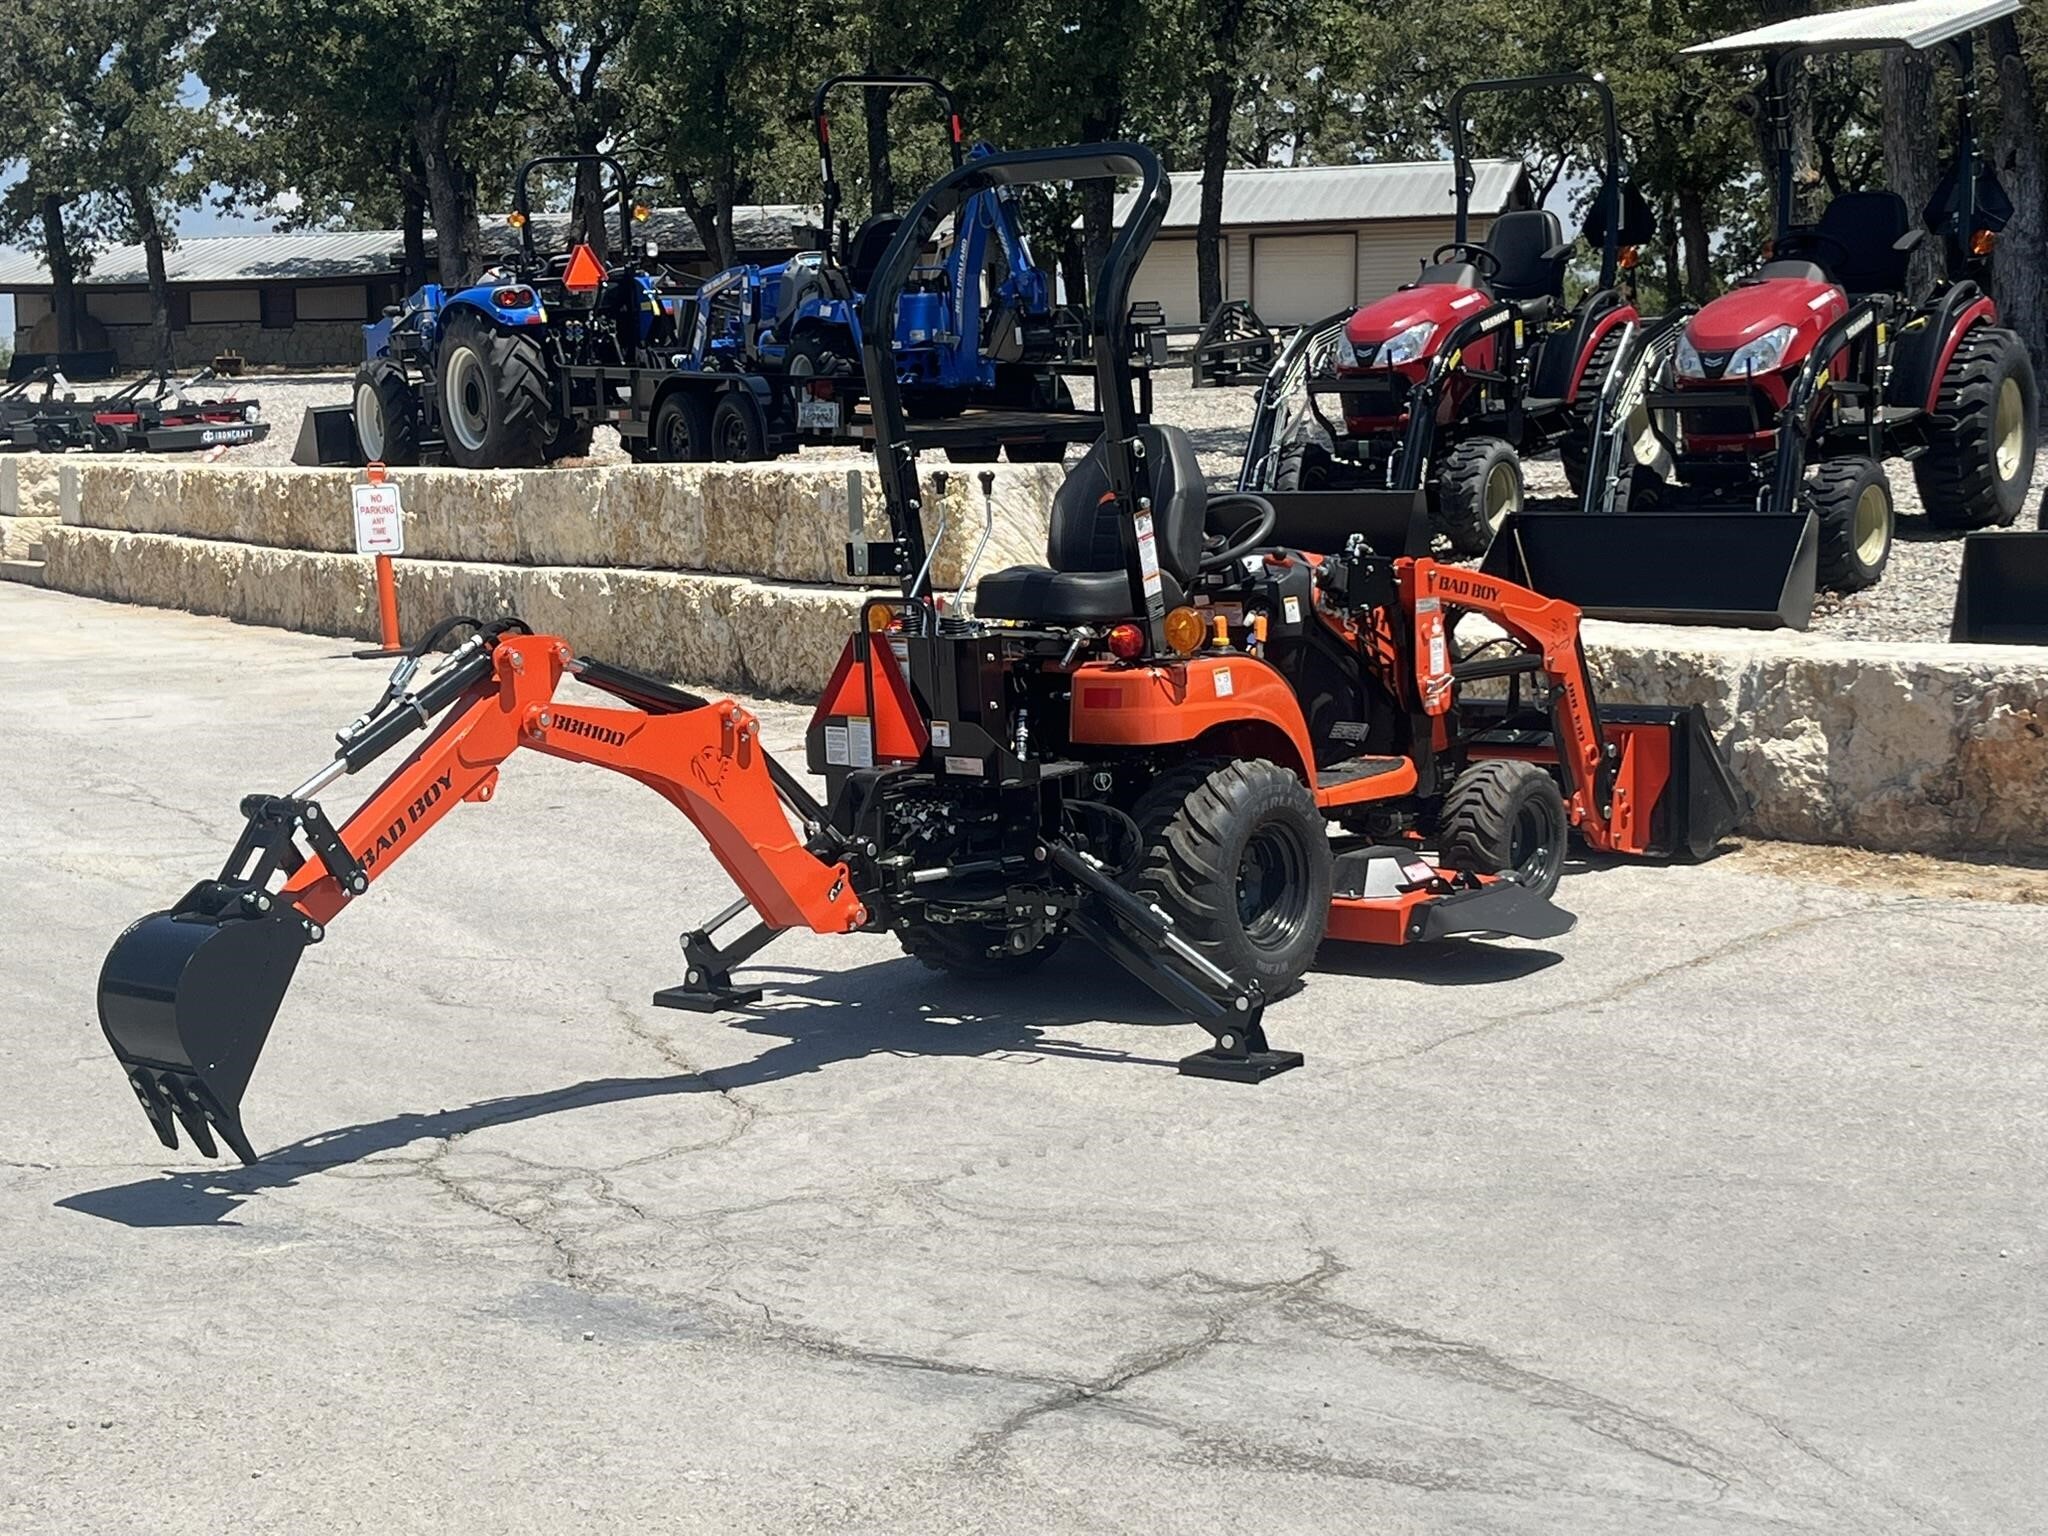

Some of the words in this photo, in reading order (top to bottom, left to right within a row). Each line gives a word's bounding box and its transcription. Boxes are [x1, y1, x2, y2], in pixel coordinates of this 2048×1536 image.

[957, 237, 969, 287] HOLLAND
[214, 429, 254, 440] IRONCRAFT
[370, 494, 383, 503] NO
[360, 505, 395, 515] PARKING
[372, 517, 385, 525] ANY
[372, 527, 387, 535] TIME
[1439, 576, 1469, 596] BAD
[1471, 583, 1501, 602] BOY
[359, 817, 407, 869] BAD
[407, 767, 452, 824] BOY
